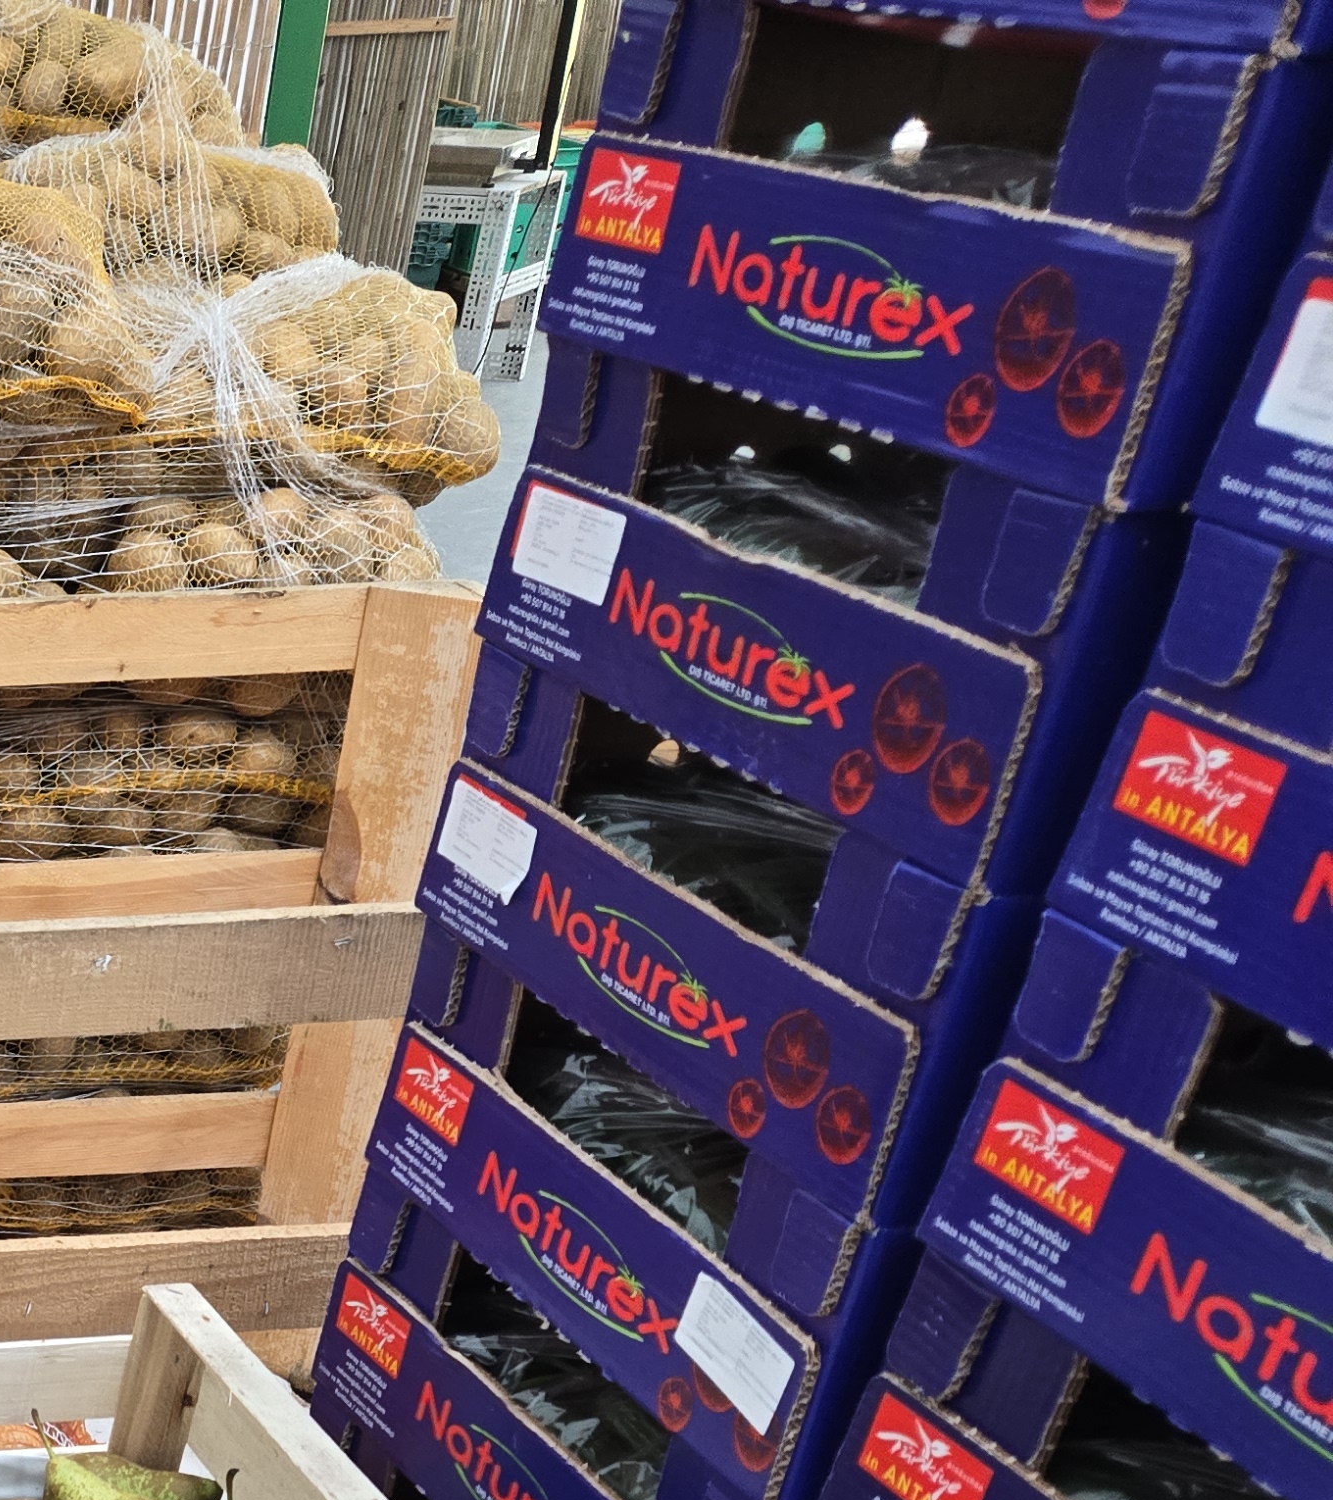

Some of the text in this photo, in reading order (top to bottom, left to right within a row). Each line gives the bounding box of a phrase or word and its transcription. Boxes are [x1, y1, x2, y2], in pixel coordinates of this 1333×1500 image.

[594, 214, 660, 247] ANTALYA
[687, 221, 974, 357] Naturex
[608, 566, 854, 731] Naturex
[1136, 756, 1246, 828] Türkiye
[1143, 793, 1250, 858] ANTALYA
[531, 871, 746, 1059] Naturex
[994, 1122, 1089, 1195] Türkiye
[1000, 1155, 1093, 1228] ANTALYA
[477, 1151, 677, 1351] Naturex
[350, 1323, 397, 1375] ANTALYA
